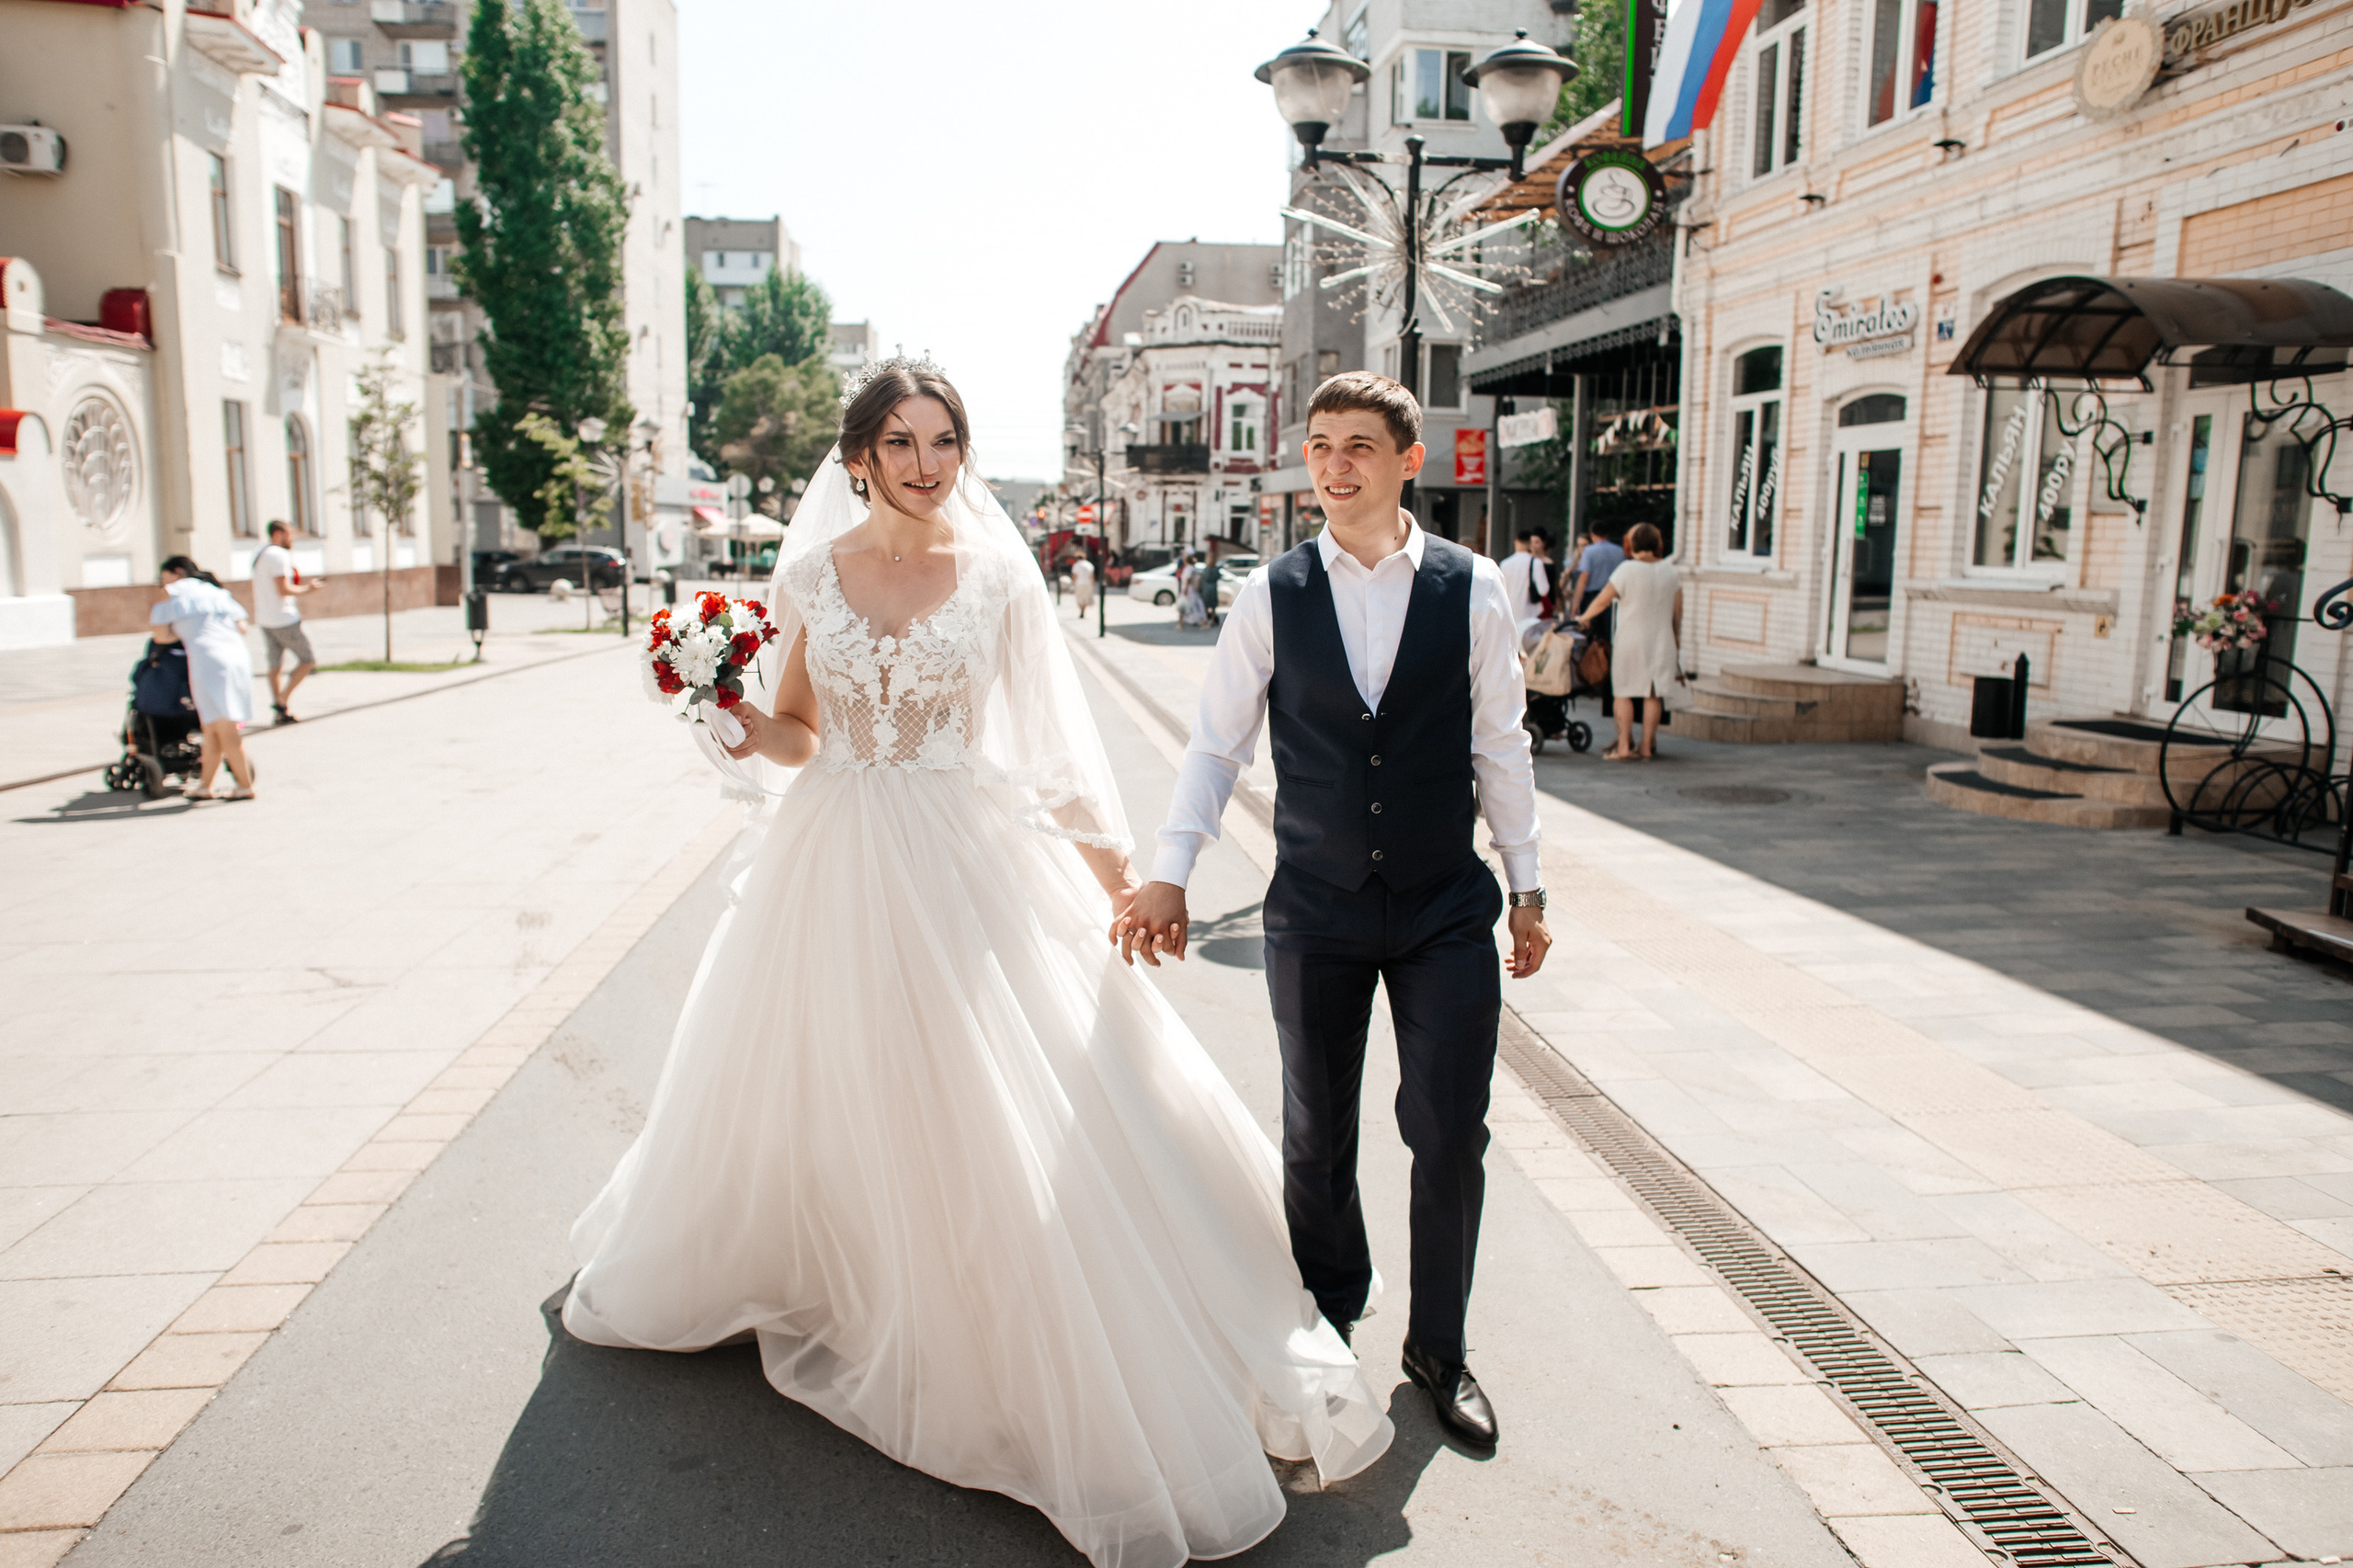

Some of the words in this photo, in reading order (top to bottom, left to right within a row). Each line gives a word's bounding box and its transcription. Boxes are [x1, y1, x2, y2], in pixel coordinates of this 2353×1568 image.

[2170, 0, 2303, 56] ФРАНЦУ
[1814, 290, 1911, 343] Emirates
[1979, 404, 2027, 518] КАЛЬЯН
